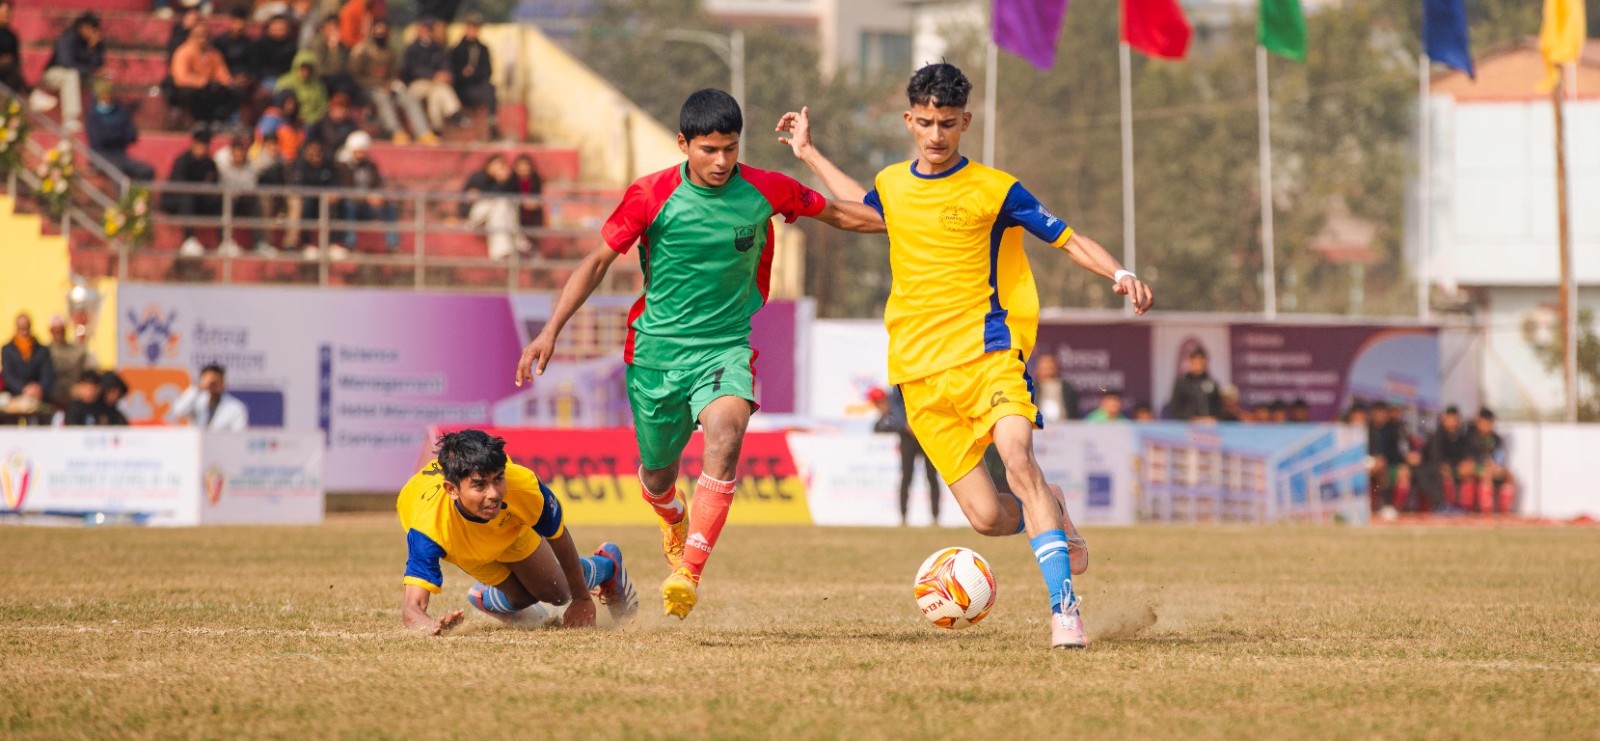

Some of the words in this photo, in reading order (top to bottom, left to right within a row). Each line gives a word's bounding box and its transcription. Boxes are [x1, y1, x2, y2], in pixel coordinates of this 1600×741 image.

[340, 345, 399, 361] Science
[339, 376, 443, 393] Management
[701, 366, 725, 393] 7
[382, 403, 486, 421] Management
